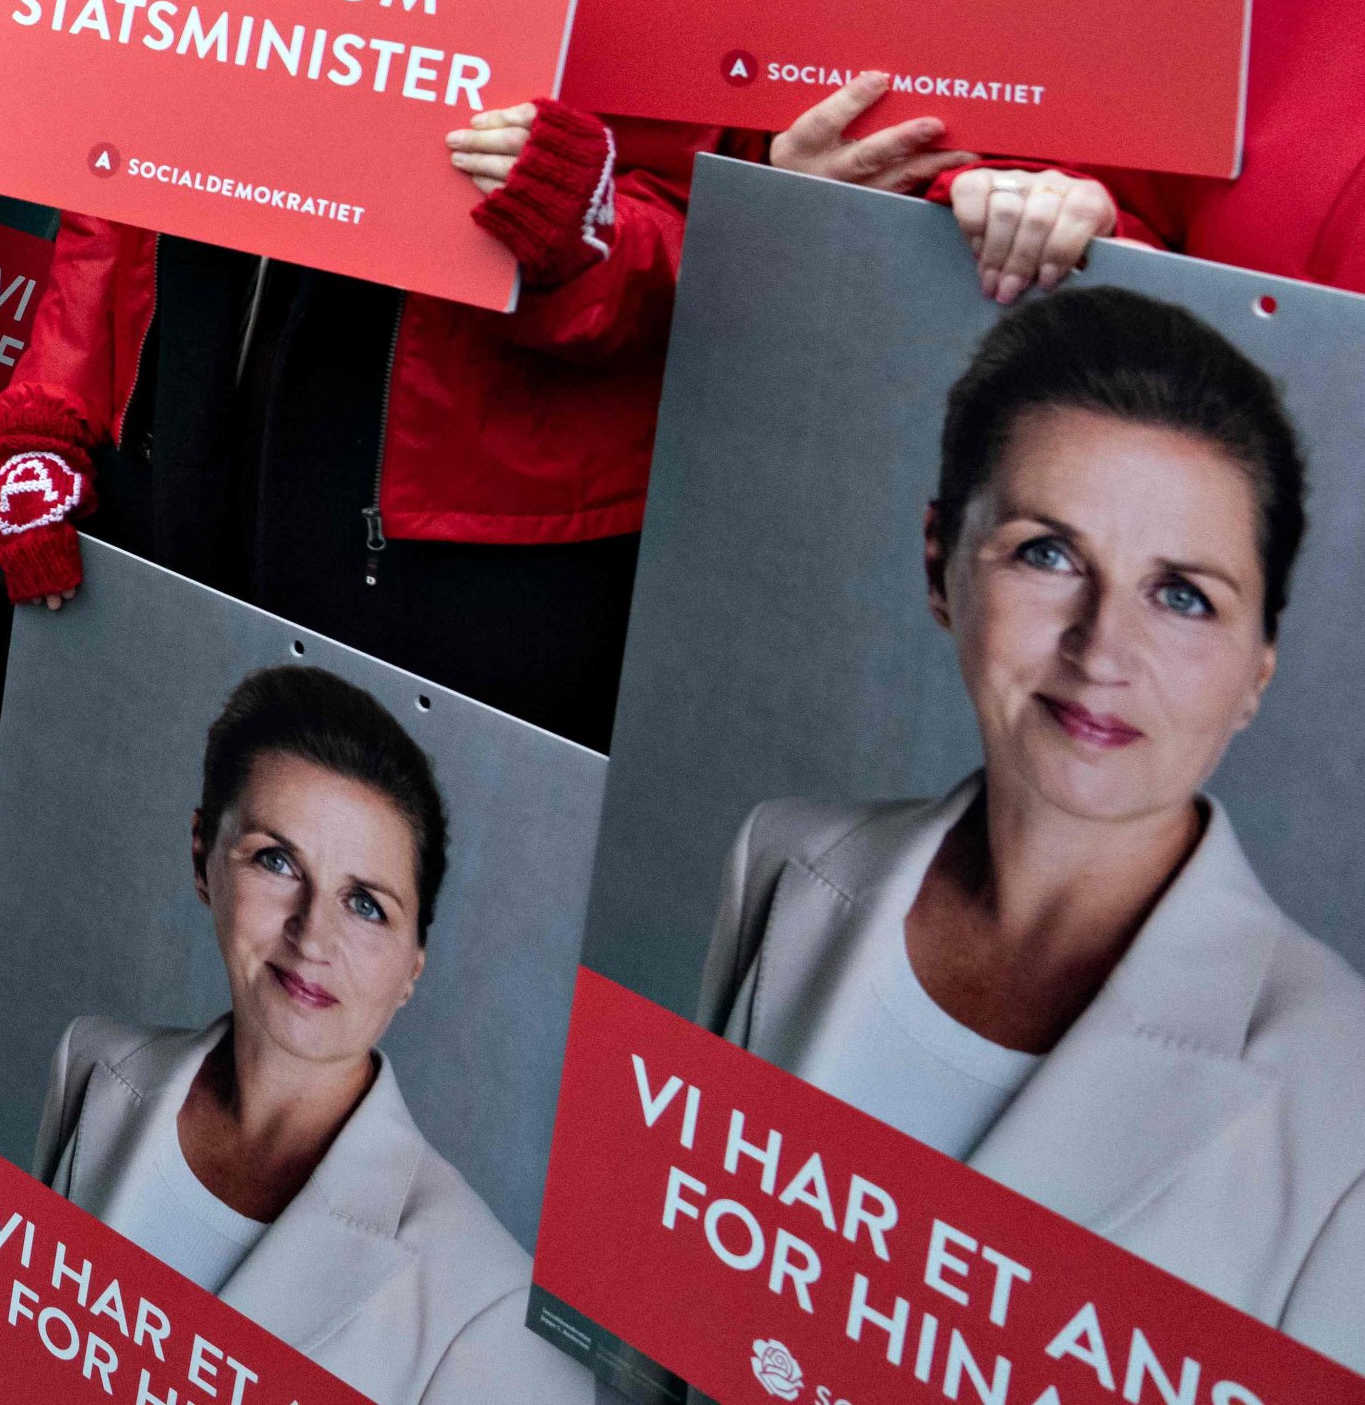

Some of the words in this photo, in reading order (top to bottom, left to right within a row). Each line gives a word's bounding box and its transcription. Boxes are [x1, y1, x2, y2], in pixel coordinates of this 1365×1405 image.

[767, 63, 1045, 105] SOCIALMOKRATIET
[127, 157, 365, 225] SOCIALDEMOKRATIET
[631, 1053, 701, 1150] VI
[723, 1108, 899, 1262] HAR
[923, 1218, 1032, 1328] ET
[661, 1165, 822, 1314] FOR
[8, 1278, 119, 1396] FOR
[51, 1240, 171, 1363] HAR
[188, 1333, 259, 1405] ET
